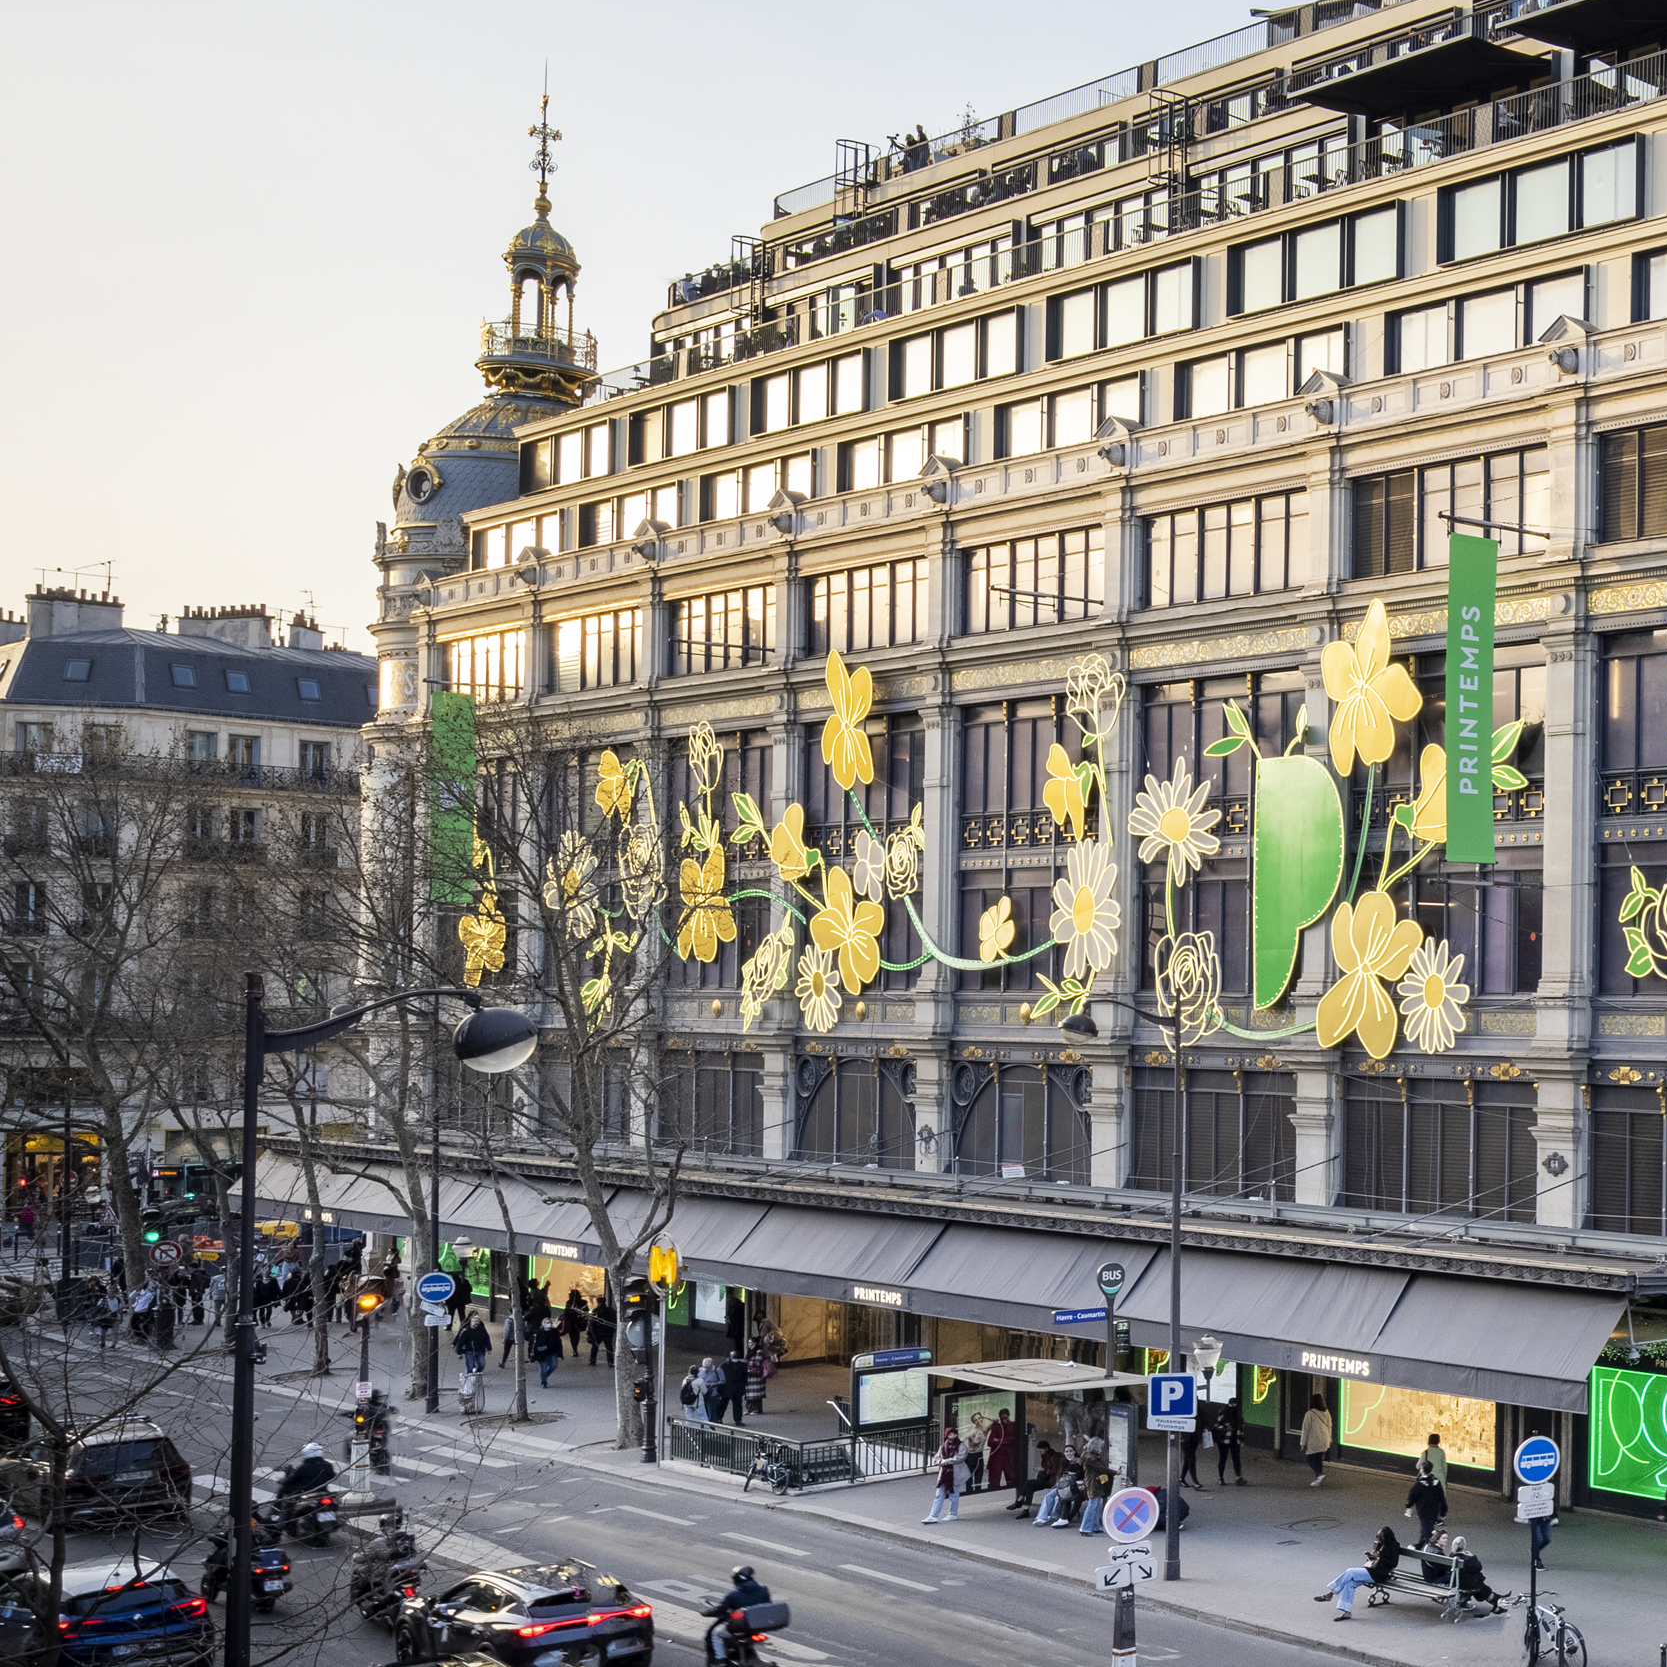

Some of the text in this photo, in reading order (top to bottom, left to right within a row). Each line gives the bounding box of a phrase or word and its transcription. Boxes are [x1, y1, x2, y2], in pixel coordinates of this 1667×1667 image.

[1459, 605, 1481, 795] PRINTEMPS
[541, 1241, 579, 1259] PRINTEMPS
[1102, 1270, 1122, 1281] BUS
[853, 1286, 902, 1306] PRINTEMPS
[1056, 1314, 1073, 1322] Havre
[1077, 1311, 1106, 1320] Caumartin
[1117, 1322, 1128, 1331] 32
[1301, 1351, 1370, 1377] PRINTEMPS
[1160, 1380, 1184, 1412] P
[1156, 1417, 1188, 1425] Haussmann
[1157, 1423, 1185, 1431] Printemps
